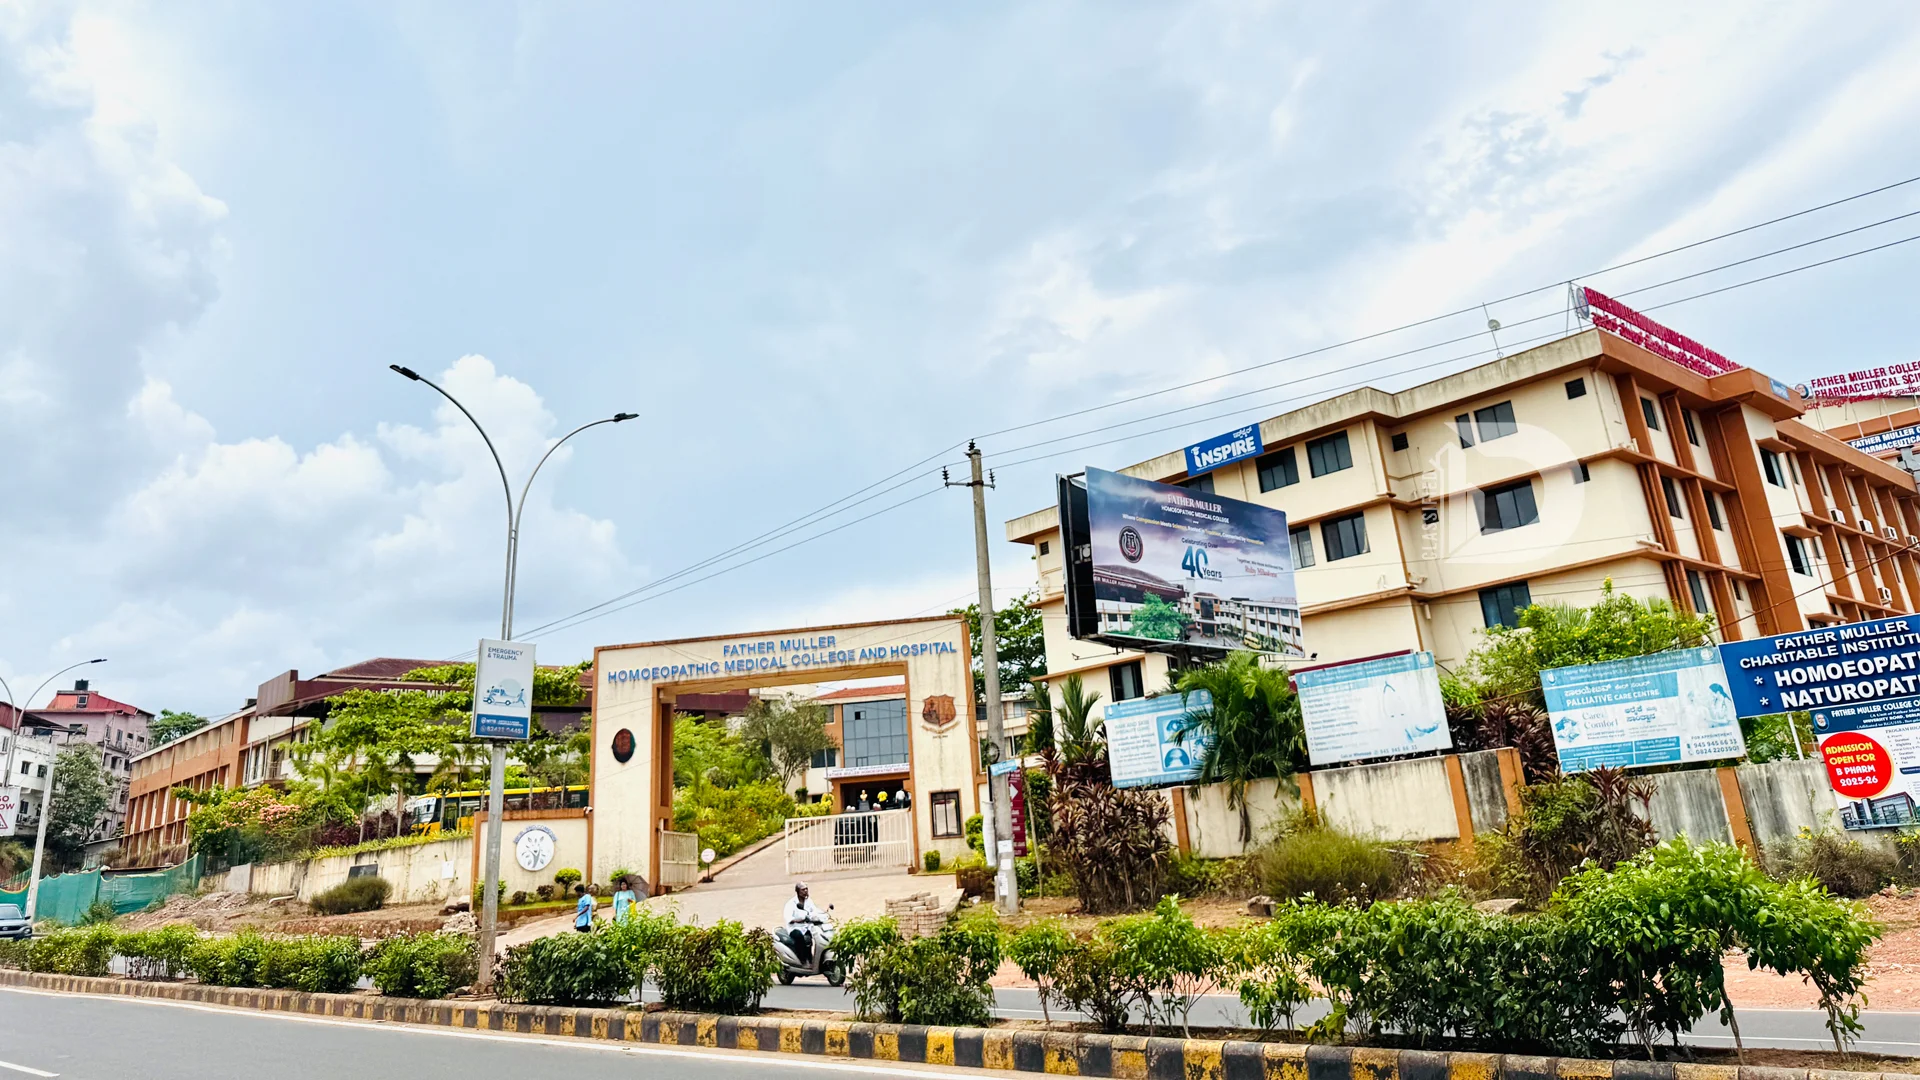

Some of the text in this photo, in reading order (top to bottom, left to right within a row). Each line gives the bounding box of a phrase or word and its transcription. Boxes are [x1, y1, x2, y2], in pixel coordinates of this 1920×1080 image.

[1811, 360, 1920, 389] FATHER MULLER COLLE
[1814, 376, 1901, 398] PHARMACEUTICAL
[1902, 372, 1920, 385] SCI
[1851, 435, 1881, 448] FATHER
[1882, 428, 1915, 441] MULLER
[1167, 493, 1223, 514] FATHER MULLER
[1181, 537, 1219, 549] Celebrating Over
[1181, 545, 1209, 580] 40
[1202, 566, 1222, 579] Years
[1774, 619, 1910, 651] FATHER MULLER
[487, 646, 524, 656] EMERGENCY
[723, 635, 836, 657] FATHER MULLER
[493, 653, 518, 661] TRAUMA
[607, 641, 958, 683] HOMOEOPATHIC MEDICAL COLLEGE AND HOSPITAL
[1739, 644, 1840, 670] CHARITABLE
[1566, 688, 1660, 707] PALLIATIVE CARE CENTRE
[1831, 707, 1857, 718] FATHER
[1856, 704, 1882, 715] MULLER
[1883, 700, 1913, 711] COLLEGE
[1584, 718, 1619, 730] Comfort
[1825, 741, 1874, 755] ADMISSION
[1829, 752, 1876, 766] OPEN FOR
[1836, 764, 1876, 776] B PHARM
[1839, 775, 1879, 788] 2025-26
